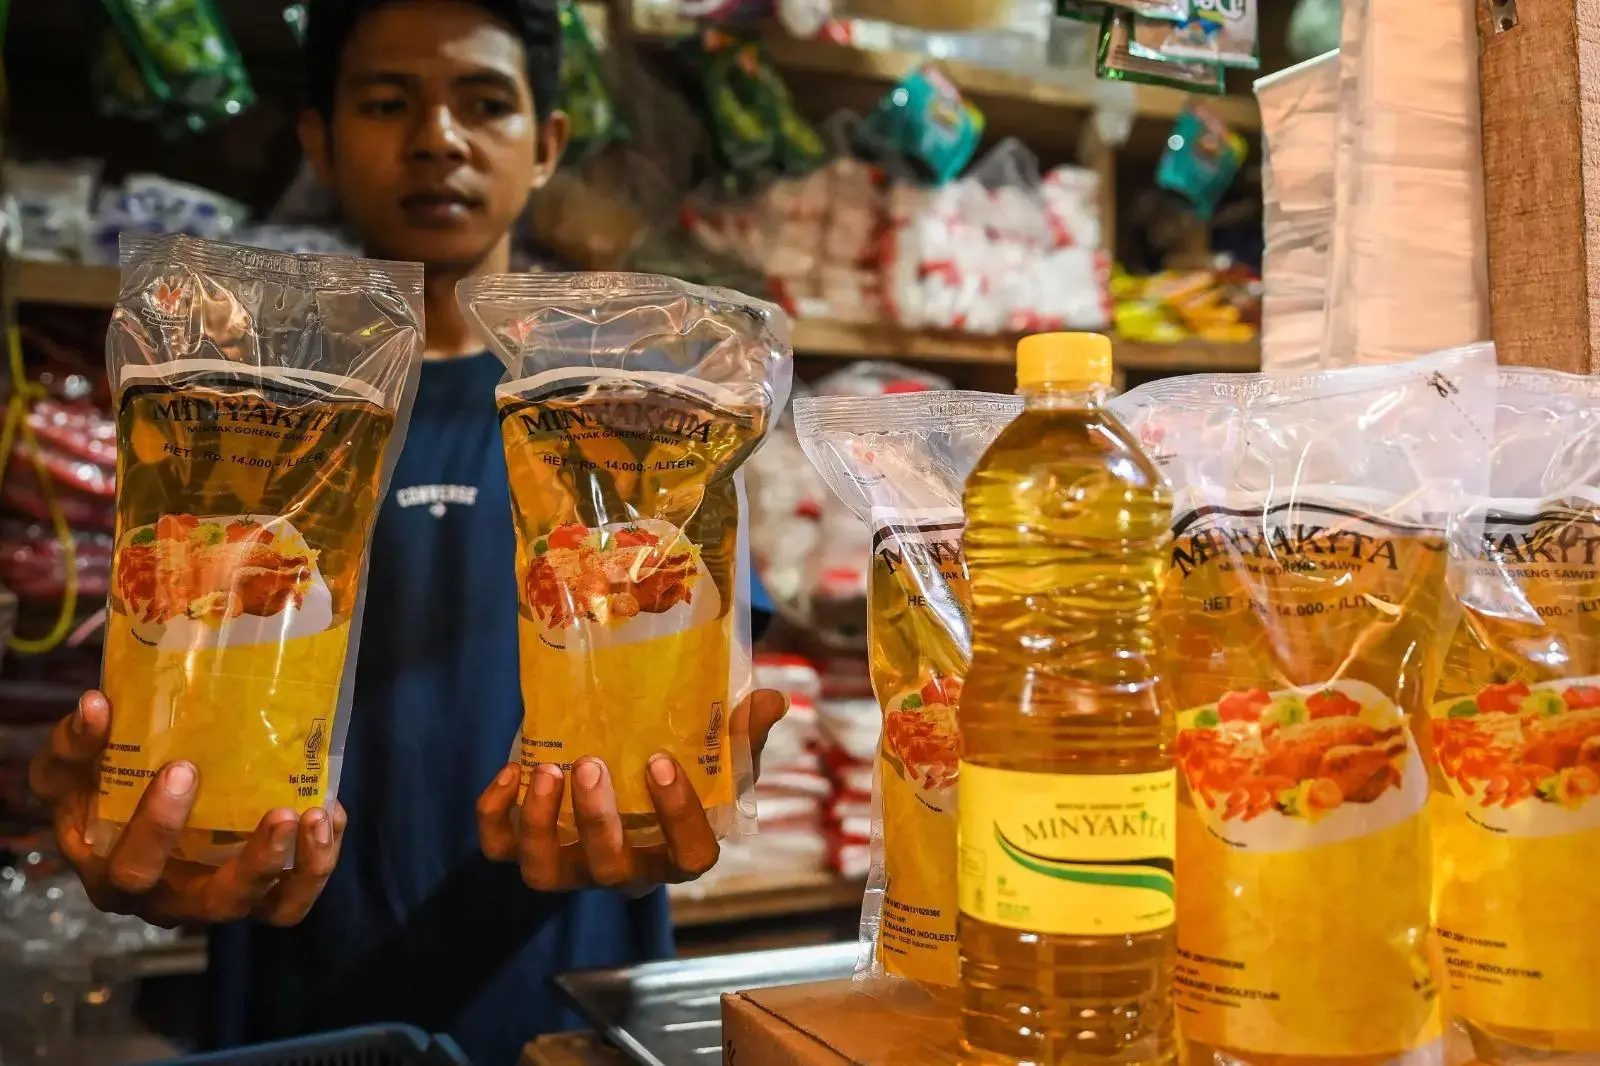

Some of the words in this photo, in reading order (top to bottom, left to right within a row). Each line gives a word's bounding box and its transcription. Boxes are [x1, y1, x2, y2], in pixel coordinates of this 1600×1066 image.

[187, 425, 232, 434] MINYAK
[234, 425, 281, 439] GORENG
[282, 432, 314, 442] SAWIT
[559, 432, 600, 442] MINYAK
[602, 431, 646, 441] GORENG
[648, 433, 681, 447] SAWIT
[163, 442, 192, 459] HET
[543, 454, 568, 468] HET
[580, 460, 600, 471] Rp.
[654, 459, 695, 470] /LITER
[1554, 568, 1596, 579] SAWIT
[1203, 596, 1232, 612] HET
[288, 774, 299, 784] Isi
[297, 786, 313, 797] 1000
[1022, 811, 1167, 845] MINYAKITA
